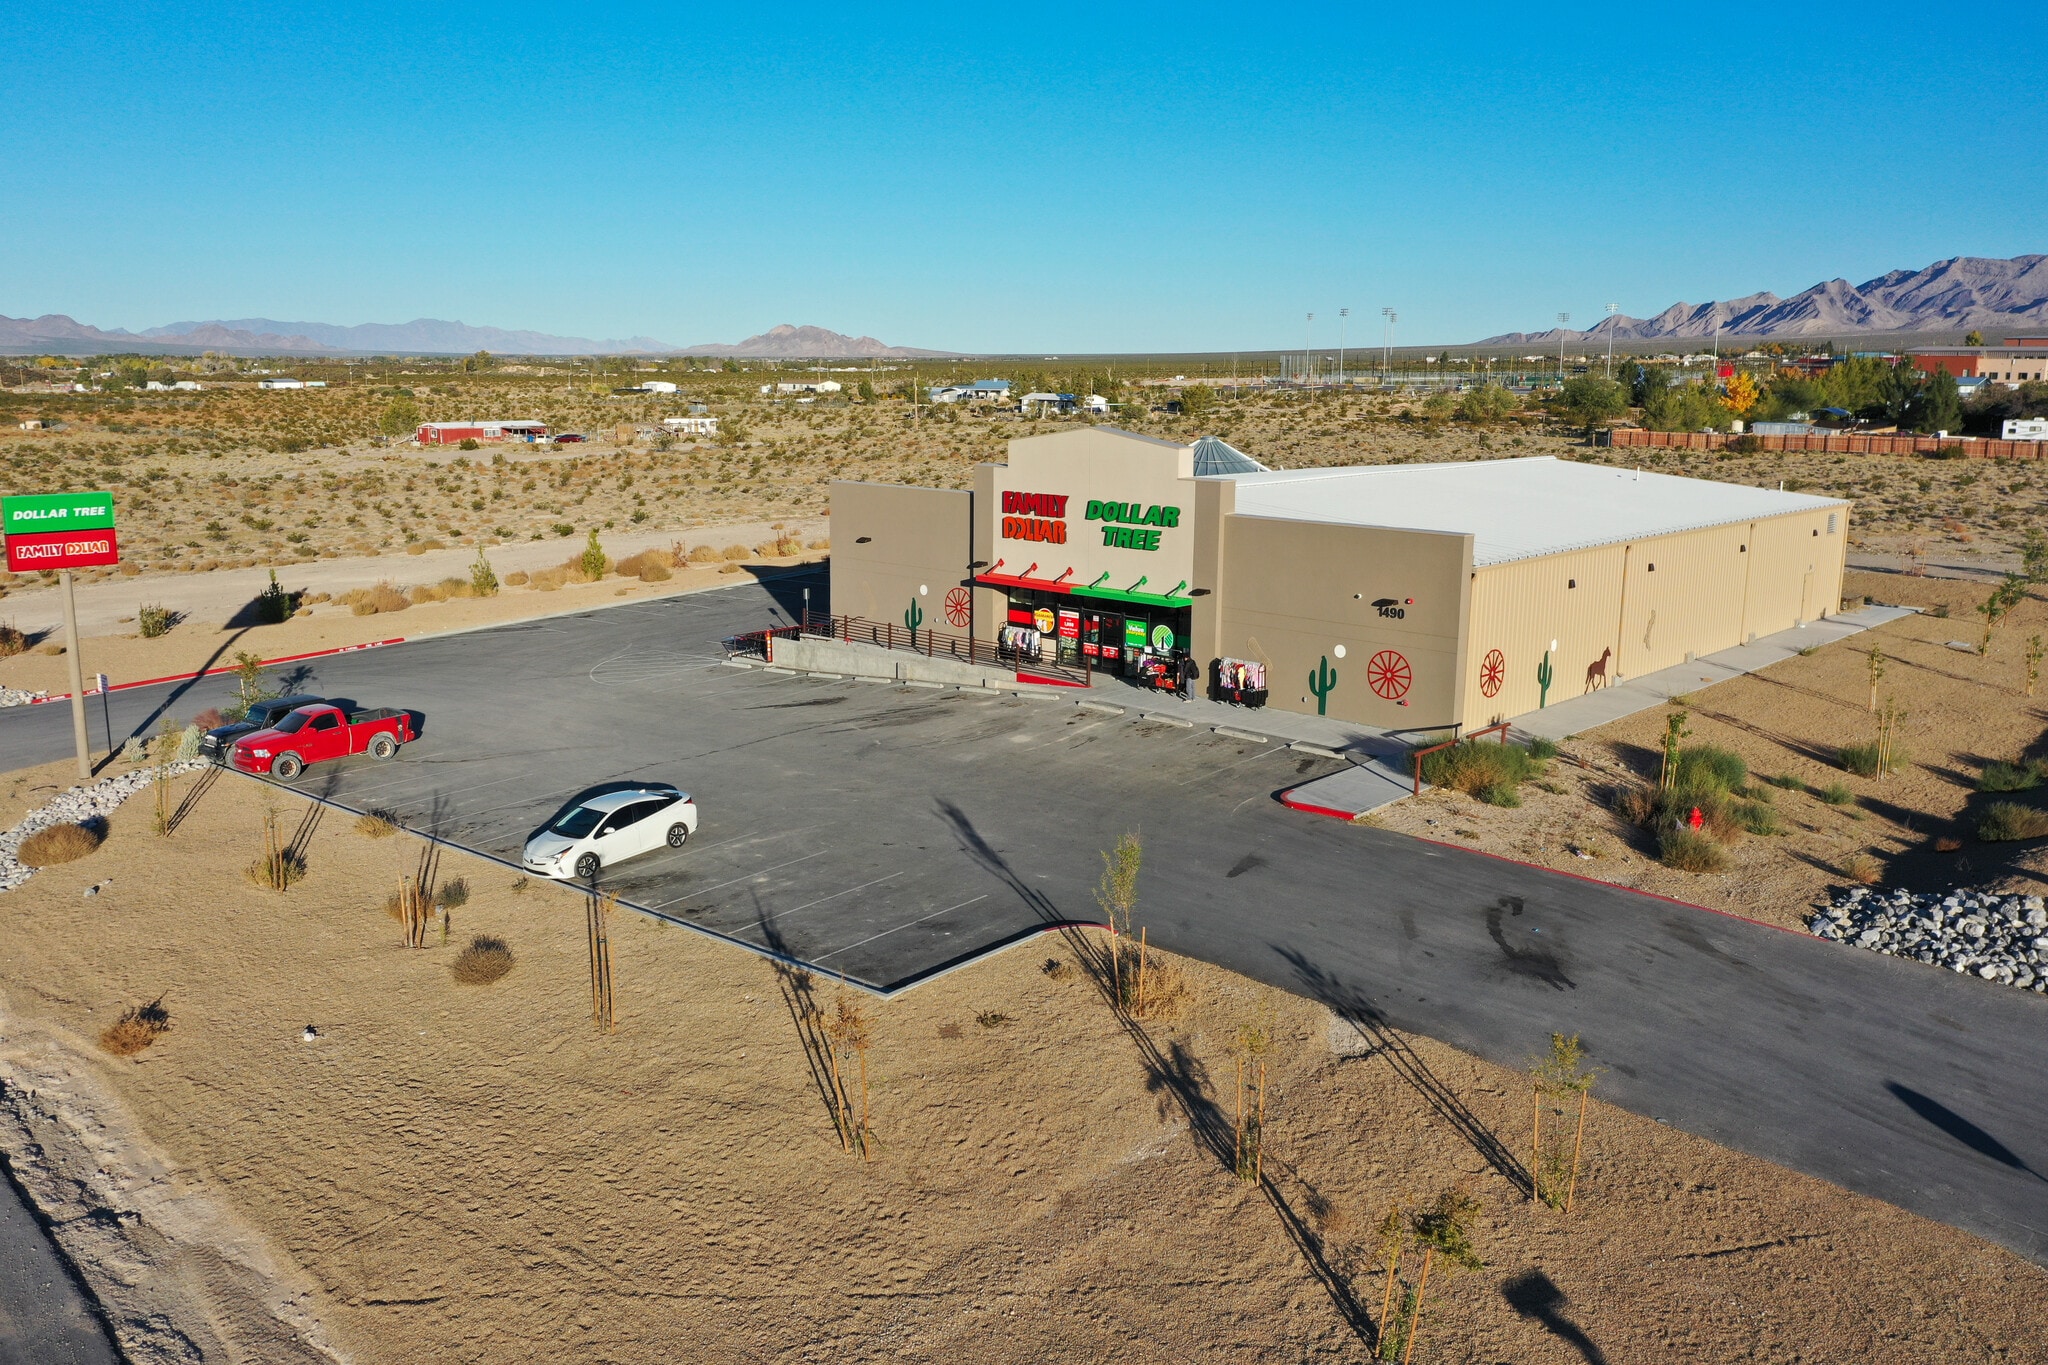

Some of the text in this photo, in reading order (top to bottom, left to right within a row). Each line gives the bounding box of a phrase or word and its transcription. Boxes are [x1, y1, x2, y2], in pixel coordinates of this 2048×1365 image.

[13, 506, 106, 520] DOLLAR TREE
[1002, 491, 1069, 518] FAMILY
[1085, 500, 1180, 527] DOLLAR
[1002, 516, 1067, 544] DOLLAR
[1101, 526, 1162, 551] TREE
[16, 540, 110, 559] FAMILY DOLLAR
[1377, 606, 1404, 619] 1490
